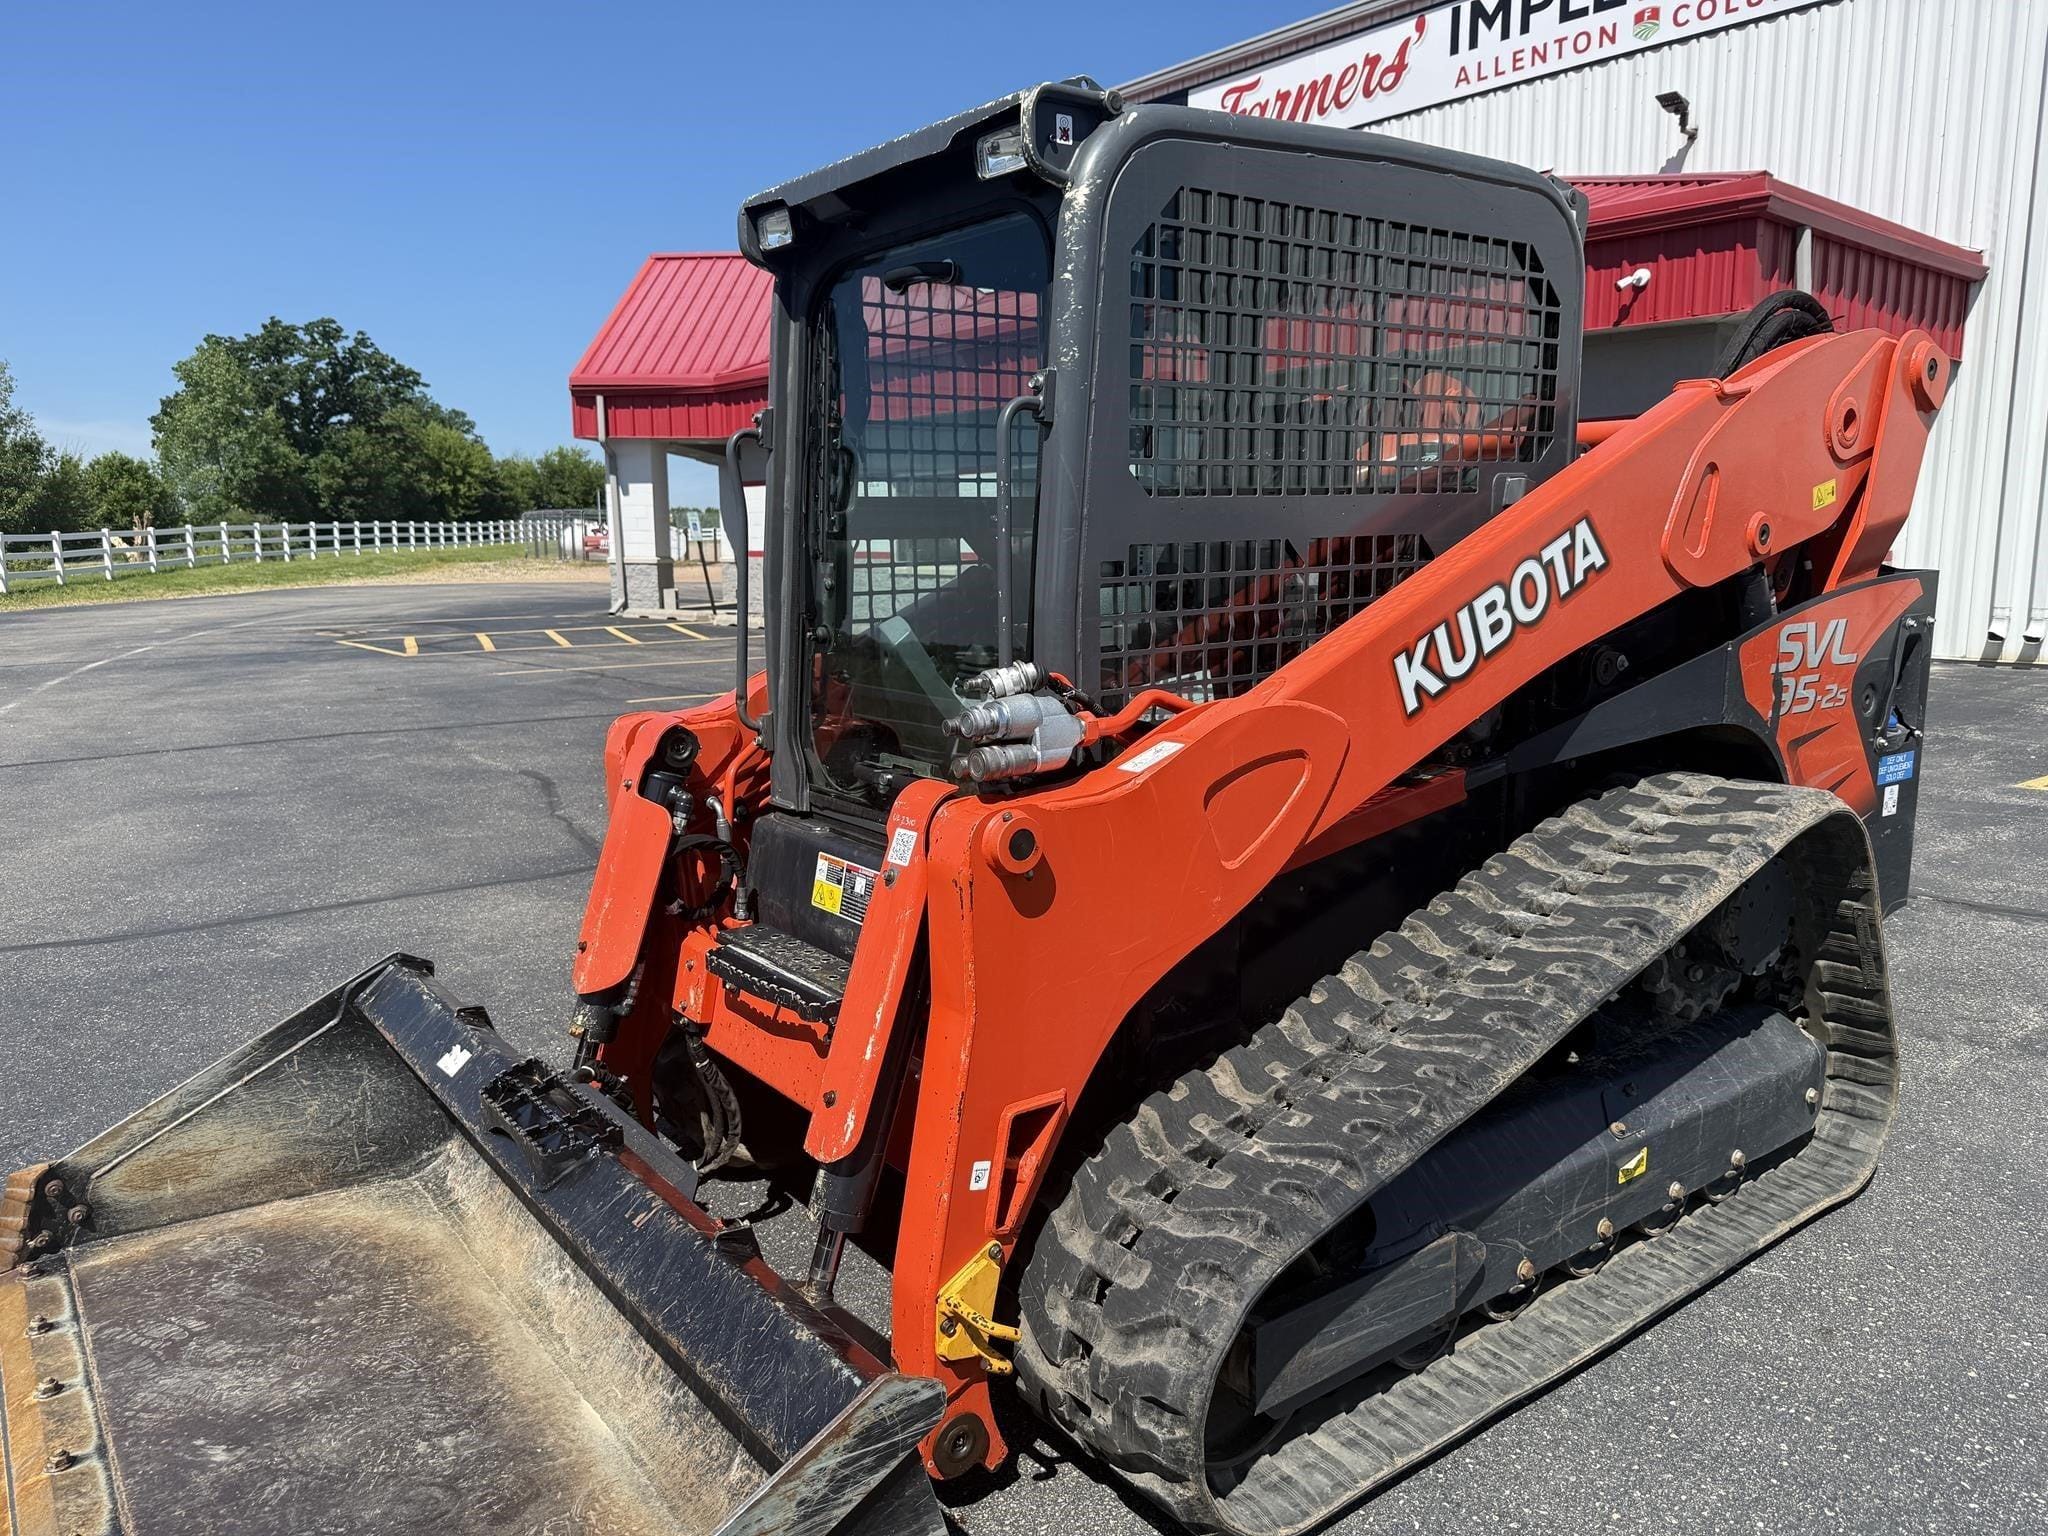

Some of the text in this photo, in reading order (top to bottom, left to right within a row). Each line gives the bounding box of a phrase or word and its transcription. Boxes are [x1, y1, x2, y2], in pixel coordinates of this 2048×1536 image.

[1450, 0, 1627, 57] IMPL
[1643, 9, 1652, 21] F
[1455, 0, 1762, 88] ALLENTON COL
[1393, 518, 1608, 716] KUBOTA
[1769, 618, 1858, 674] SVL
